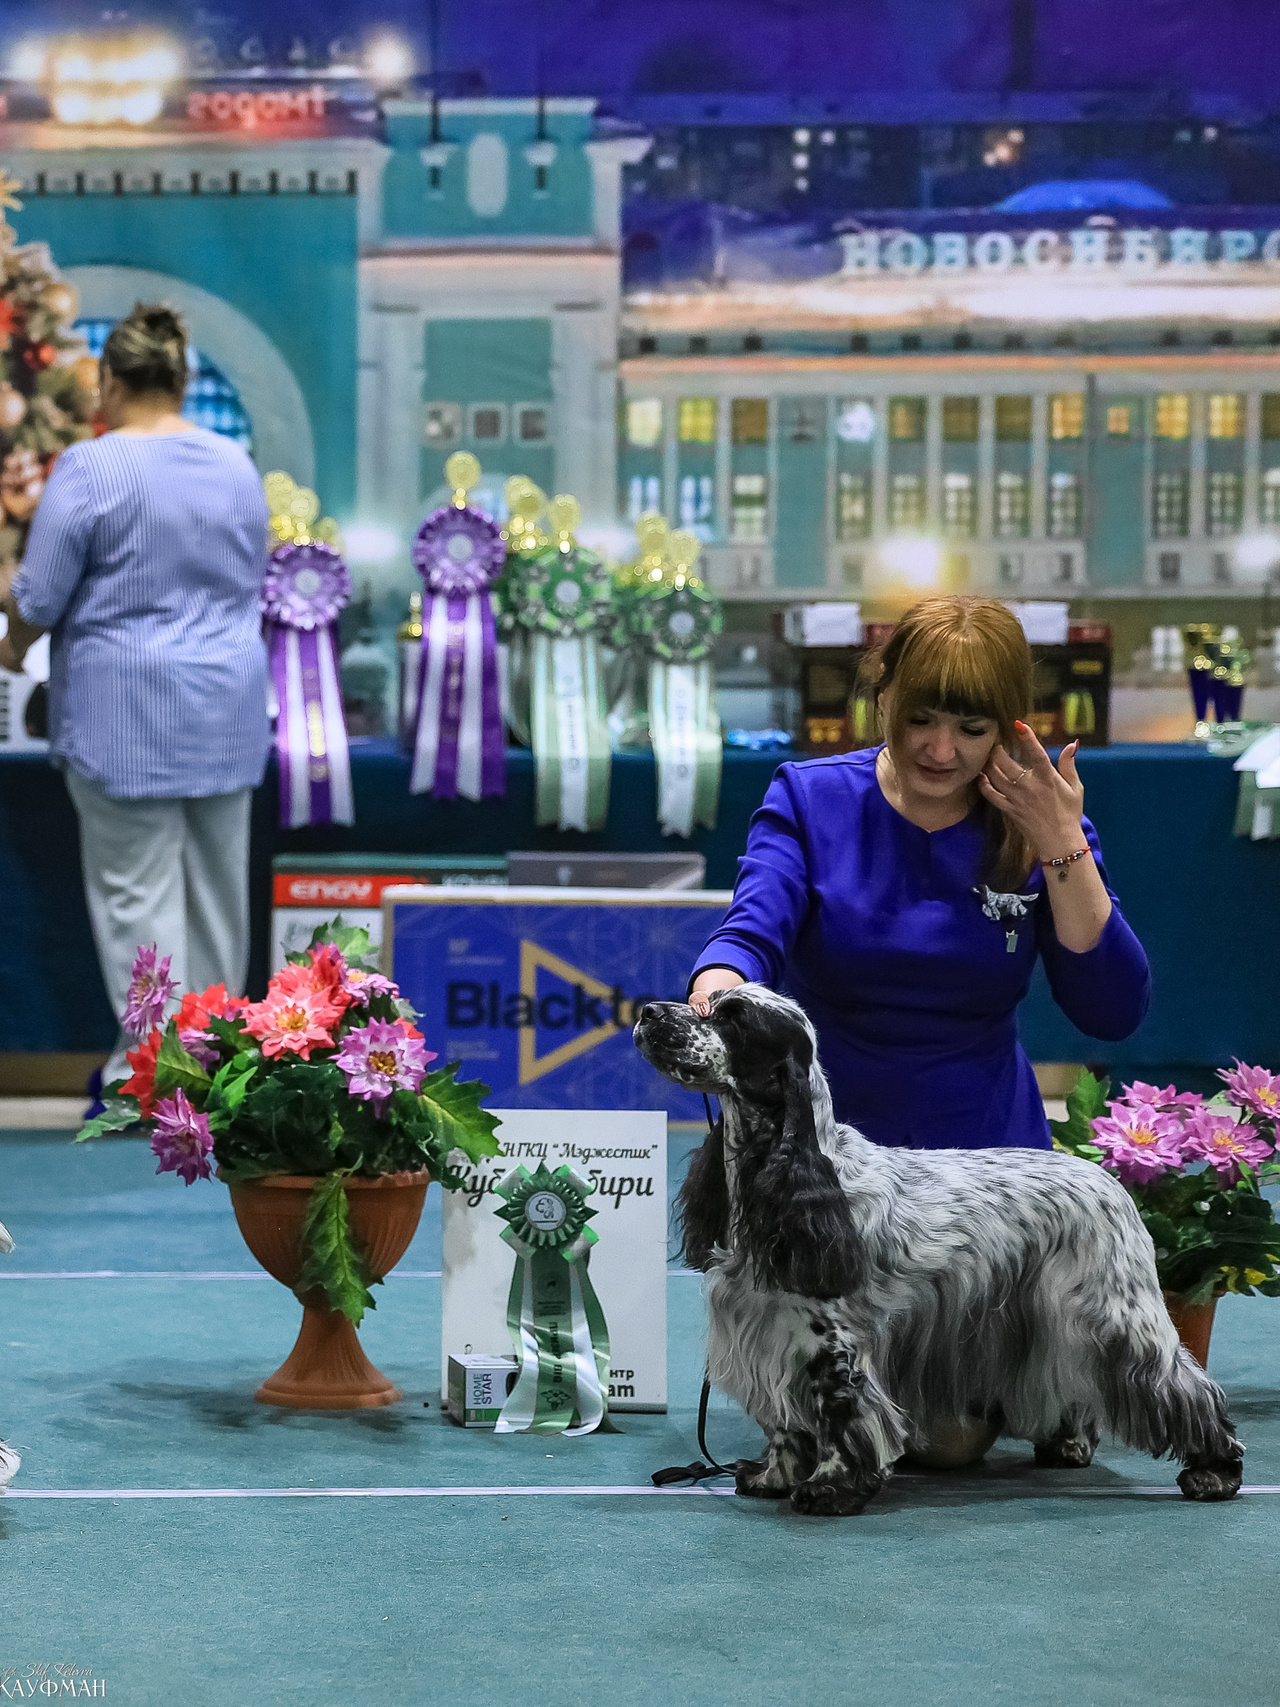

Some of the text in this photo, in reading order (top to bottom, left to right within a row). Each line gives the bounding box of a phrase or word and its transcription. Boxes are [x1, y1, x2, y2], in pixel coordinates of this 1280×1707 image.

[503, 1142, 548, 1162] НГКЦ
[472, 1373, 481, 1405] HOME
[481, 1373, 492, 1405] STAR
